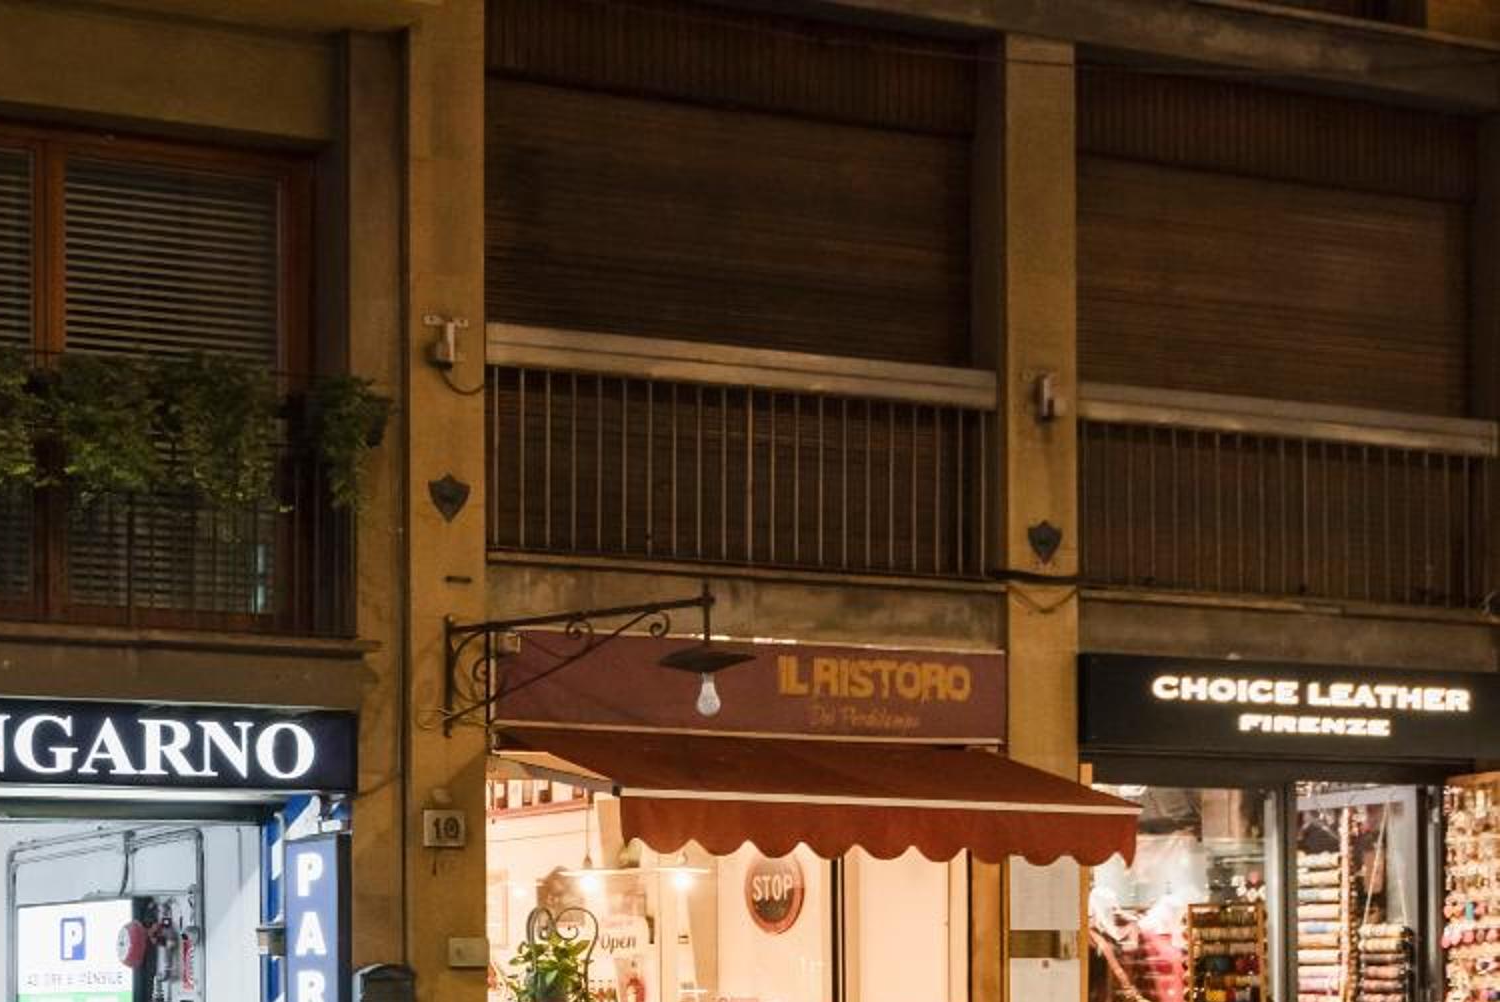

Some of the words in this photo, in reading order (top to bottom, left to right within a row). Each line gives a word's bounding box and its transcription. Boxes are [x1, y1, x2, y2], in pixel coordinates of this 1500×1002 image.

[777, 655, 808, 696] IL
[813, 656, 971, 702] RISTORO
[1151, 676, 1299, 705] CHOICE
[1306, 682, 1471, 712] LEATHER
[1238, 714, 1391, 737] FIRENZE
[751, 874, 794, 901] STOP
[601, 934, 637, 954] Open
